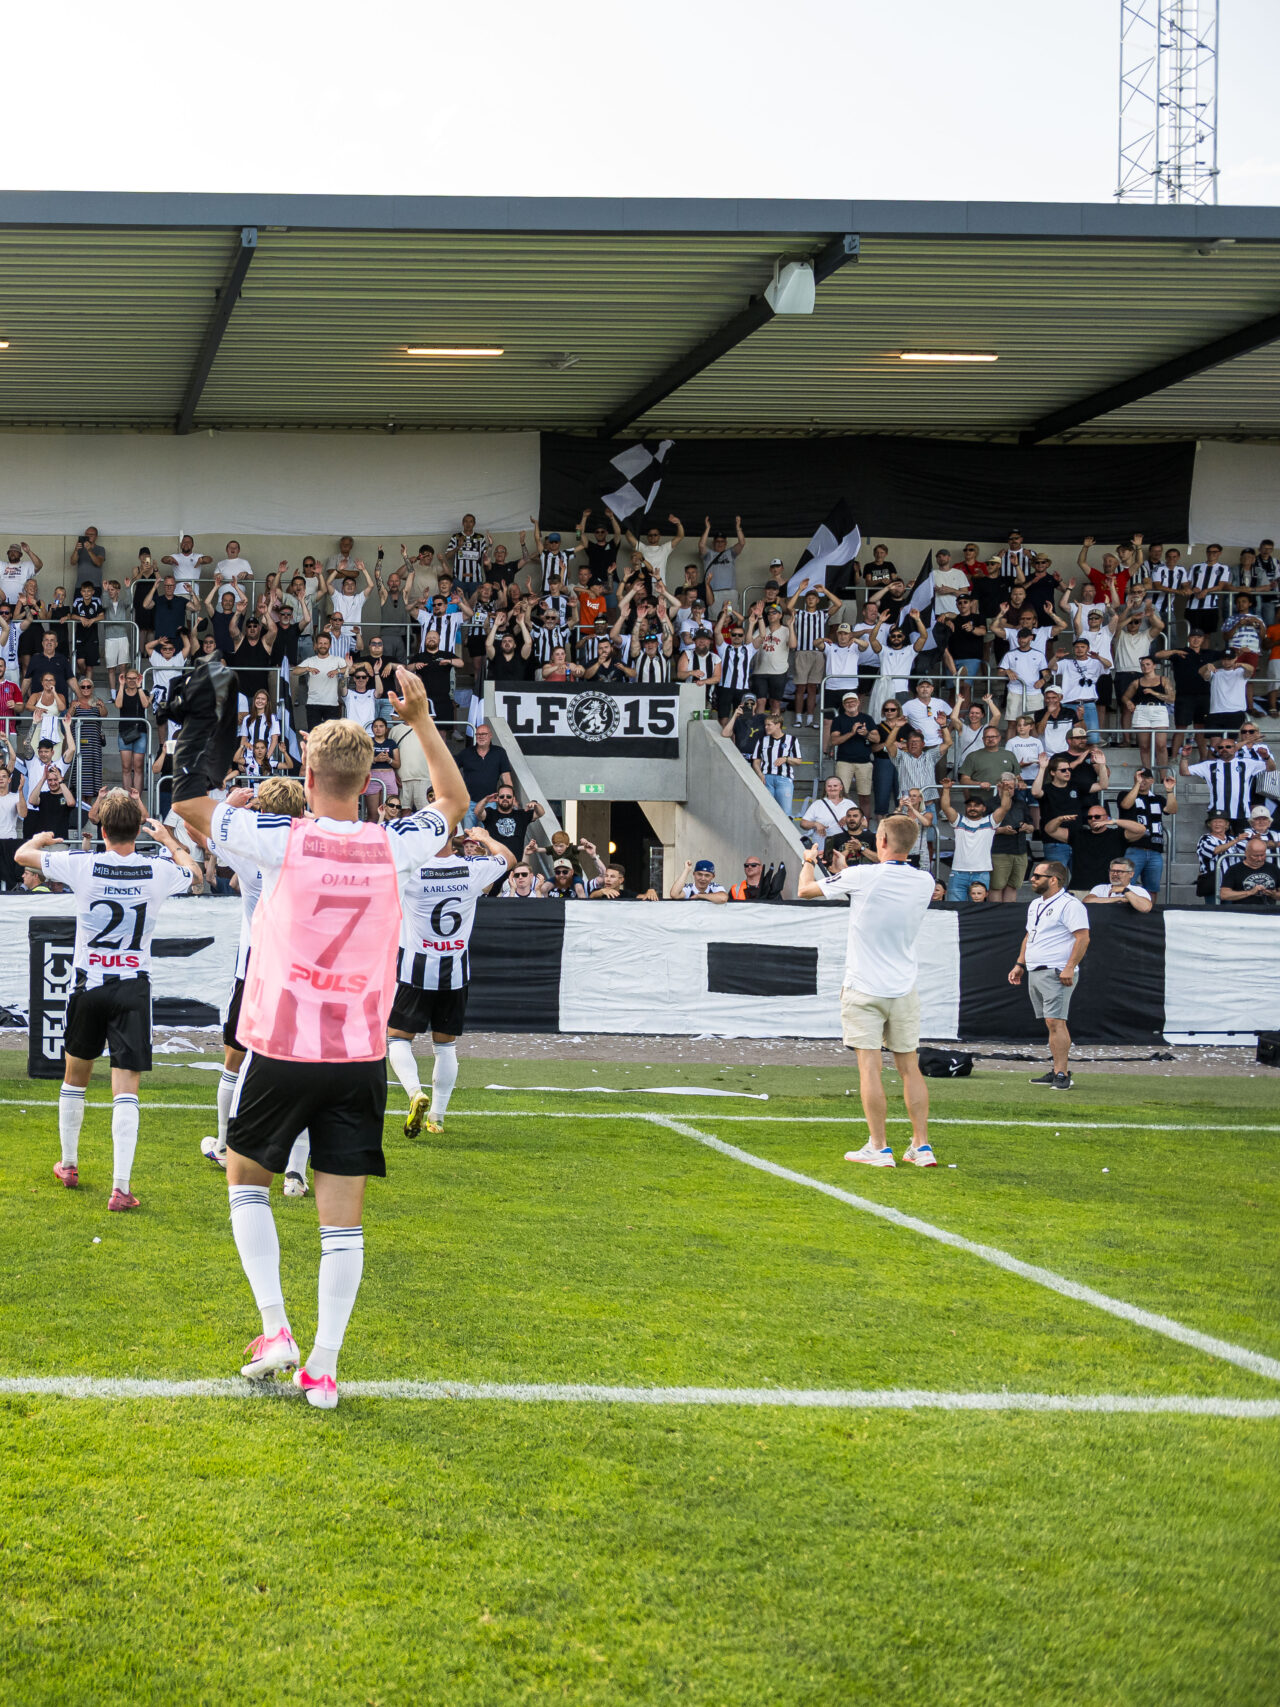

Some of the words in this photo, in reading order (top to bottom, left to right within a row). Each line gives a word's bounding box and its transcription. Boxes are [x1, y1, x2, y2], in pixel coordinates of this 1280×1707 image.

[502, 695, 567, 734] LF
[623, 699, 676, 735] 15
[110, 869, 153, 877] Automotive
[321, 873, 370, 887] OJALA
[434, 868, 469, 877] Automotive
[104, 886, 142, 896] JENSEN
[423, 884, 469, 893] KARLSSON
[430, 896, 463, 937] 6
[87, 900, 148, 951] 21
[312, 895, 372, 970] 7
[422, 938, 465, 952] PULS
[89, 953, 140, 968] PULS
[289, 963, 369, 994] PULS
[42, 942, 75, 1060] SELECT
